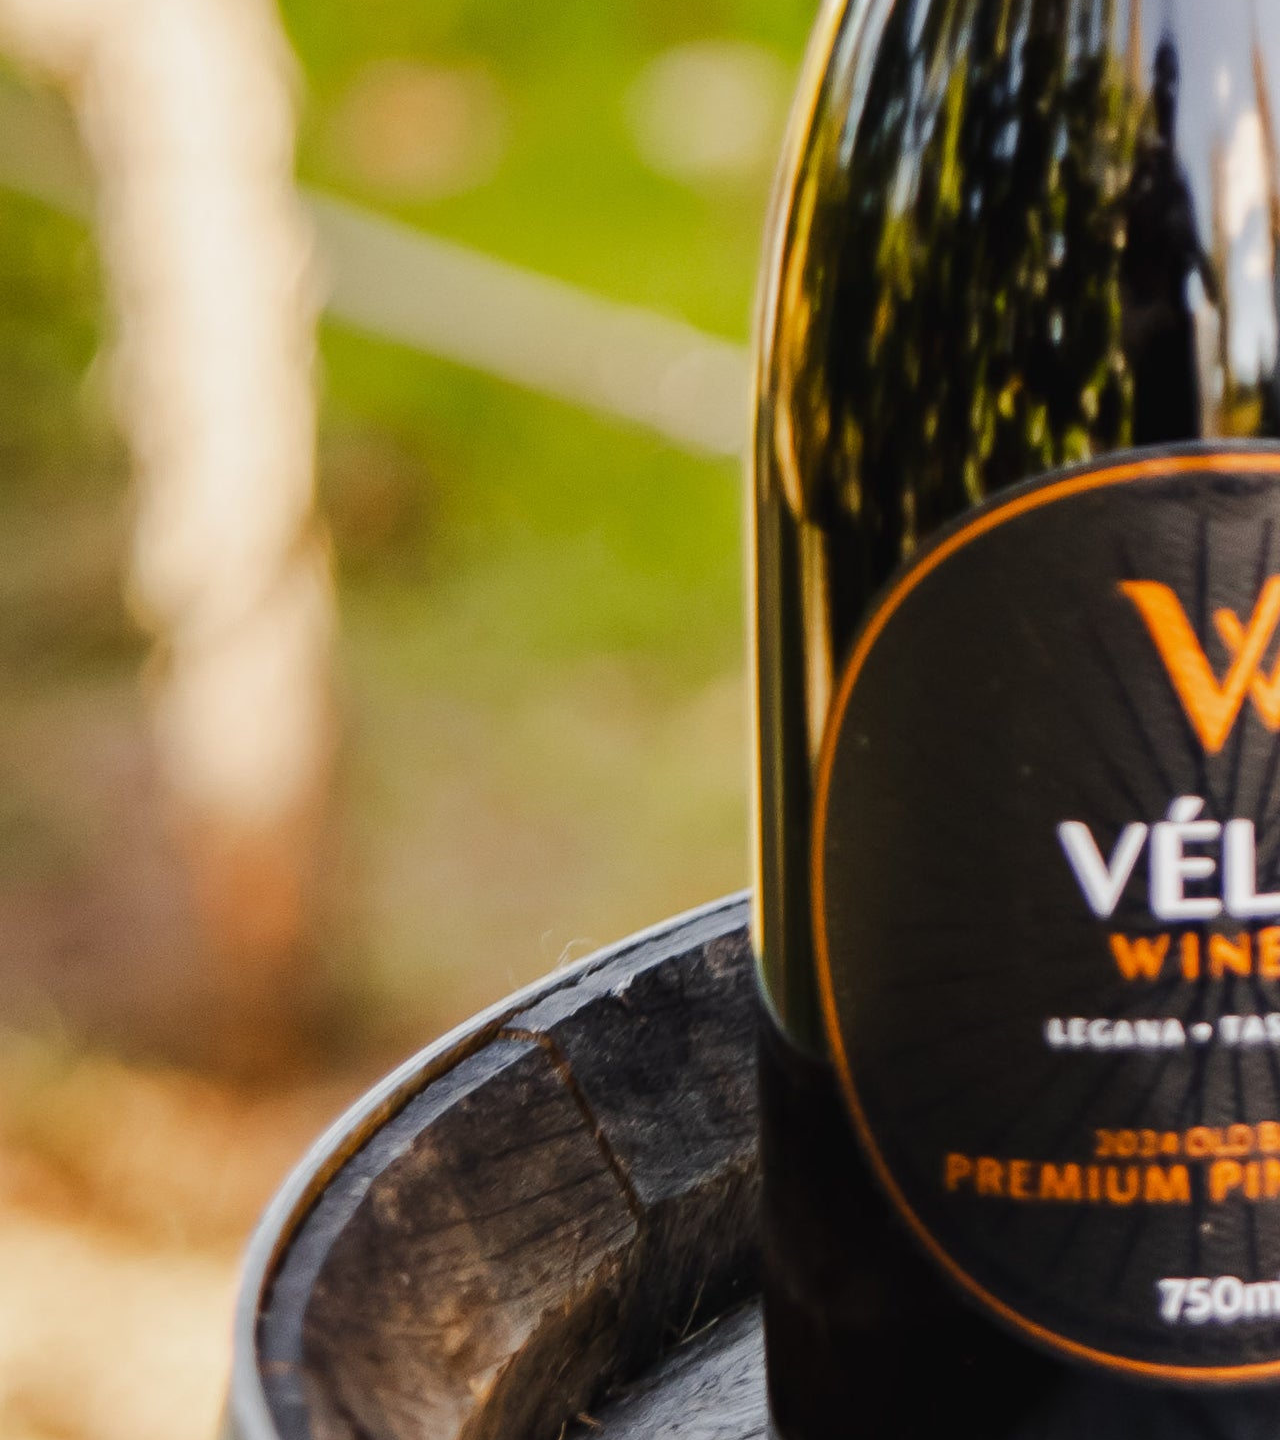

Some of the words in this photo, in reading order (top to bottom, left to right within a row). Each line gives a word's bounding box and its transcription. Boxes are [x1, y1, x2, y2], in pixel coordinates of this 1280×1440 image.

[1047, 1017, 1186, 1048] LEGANA
[1184, 1122, 1255, 1158] OLD
[945, 1152, 1192, 1205] PREMIUM
